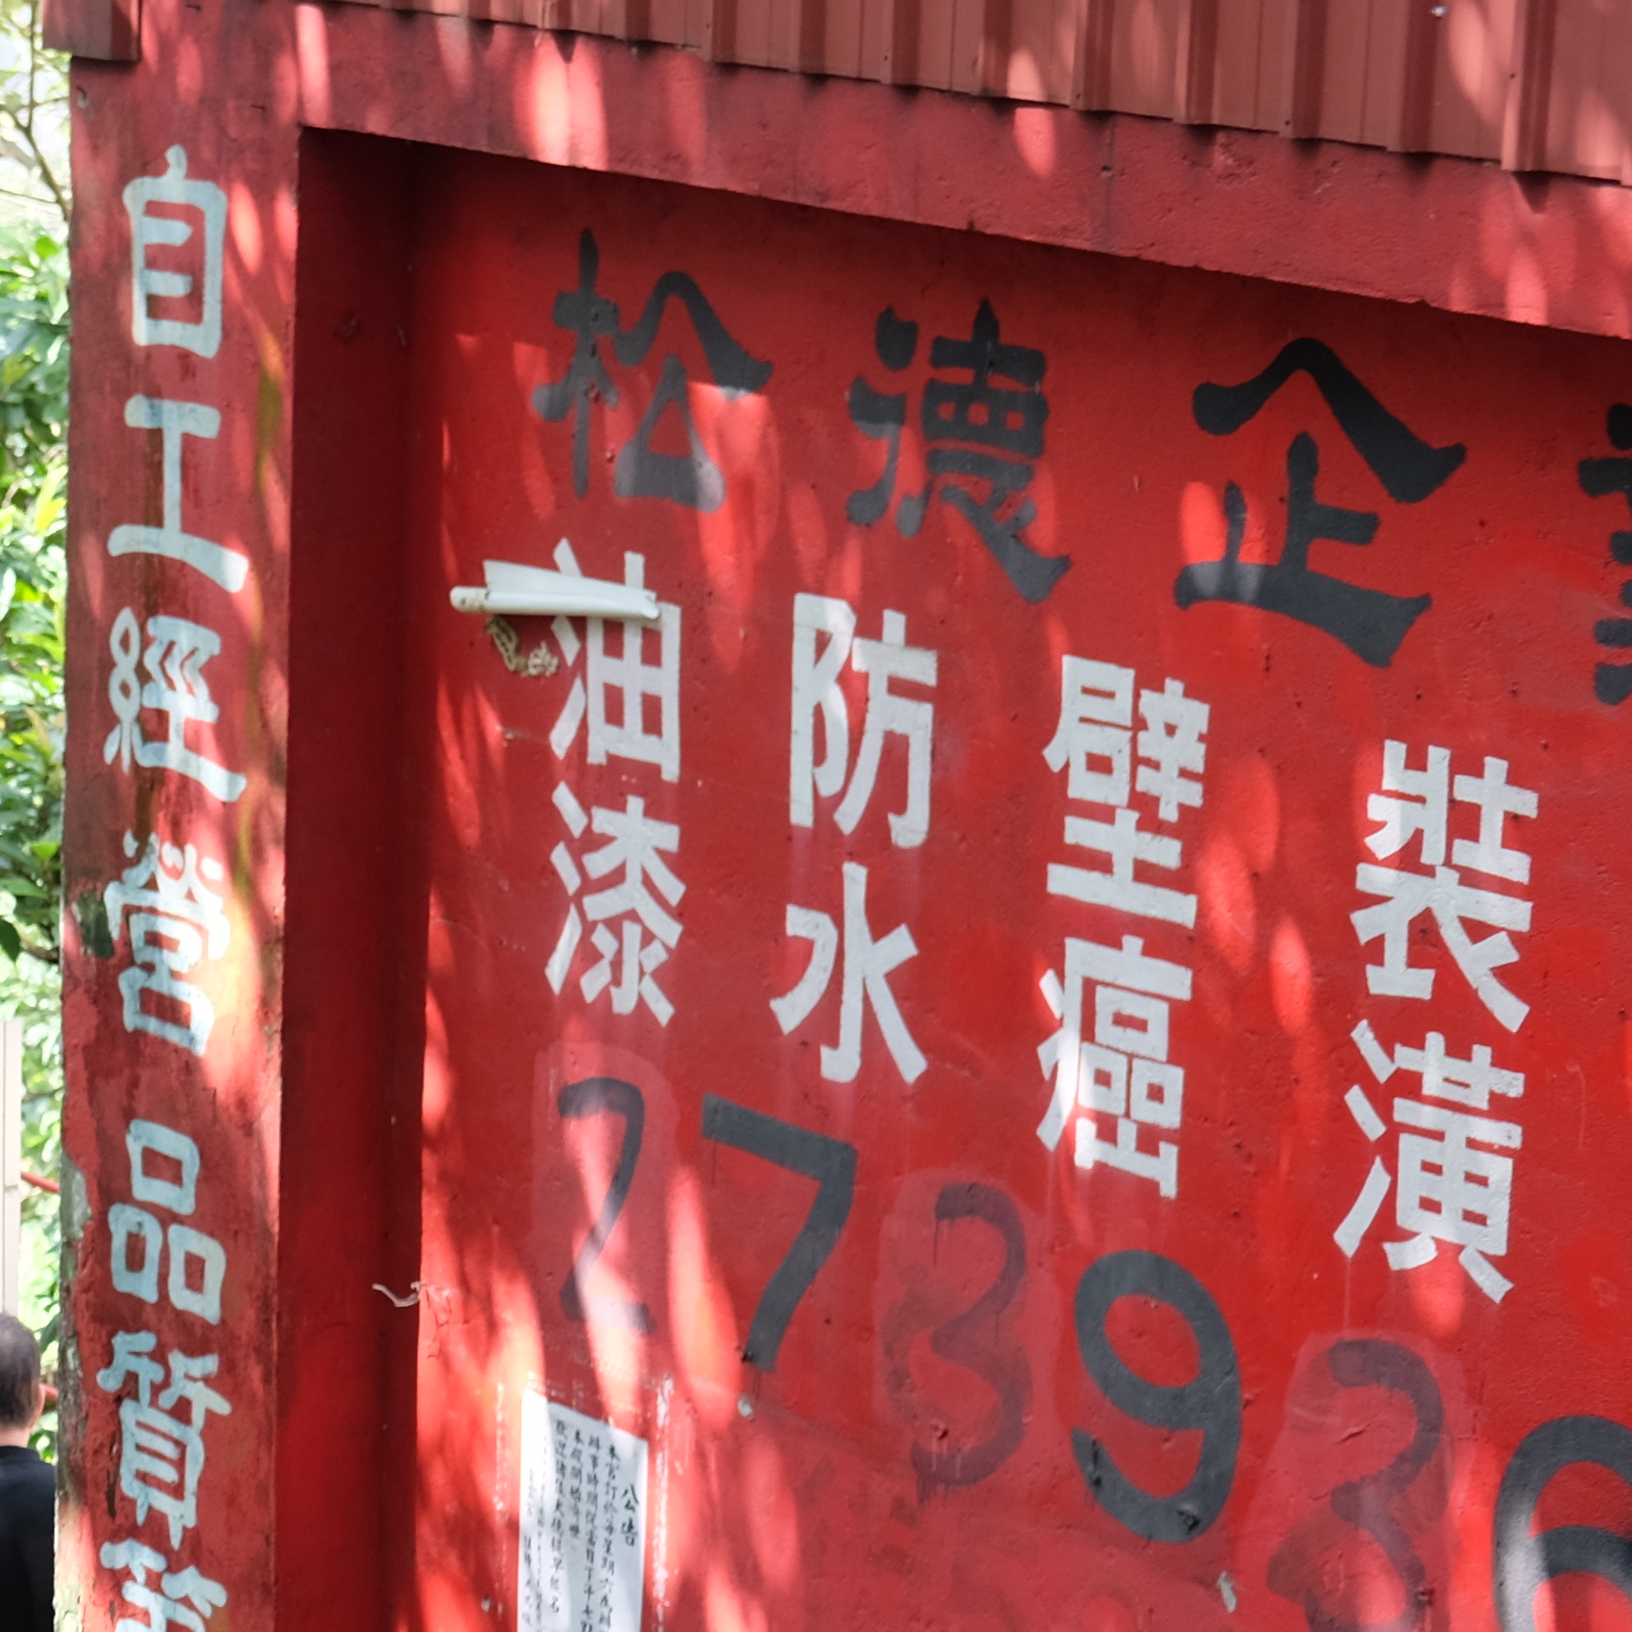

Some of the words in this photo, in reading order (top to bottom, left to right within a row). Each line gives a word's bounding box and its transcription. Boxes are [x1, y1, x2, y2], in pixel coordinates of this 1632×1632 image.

[102, 145, 249, 1057] 自工經營
[532, 227, 1632, 706] 松德企
[545, 539, 685, 1027] 油漆
[770, 592, 940, 1084] 防水
[1036, 654, 1211, 1199] 壁癌
[1333, 739, 1540, 1303] 裝潢
[622, 1482, 639, 1546] 公告
